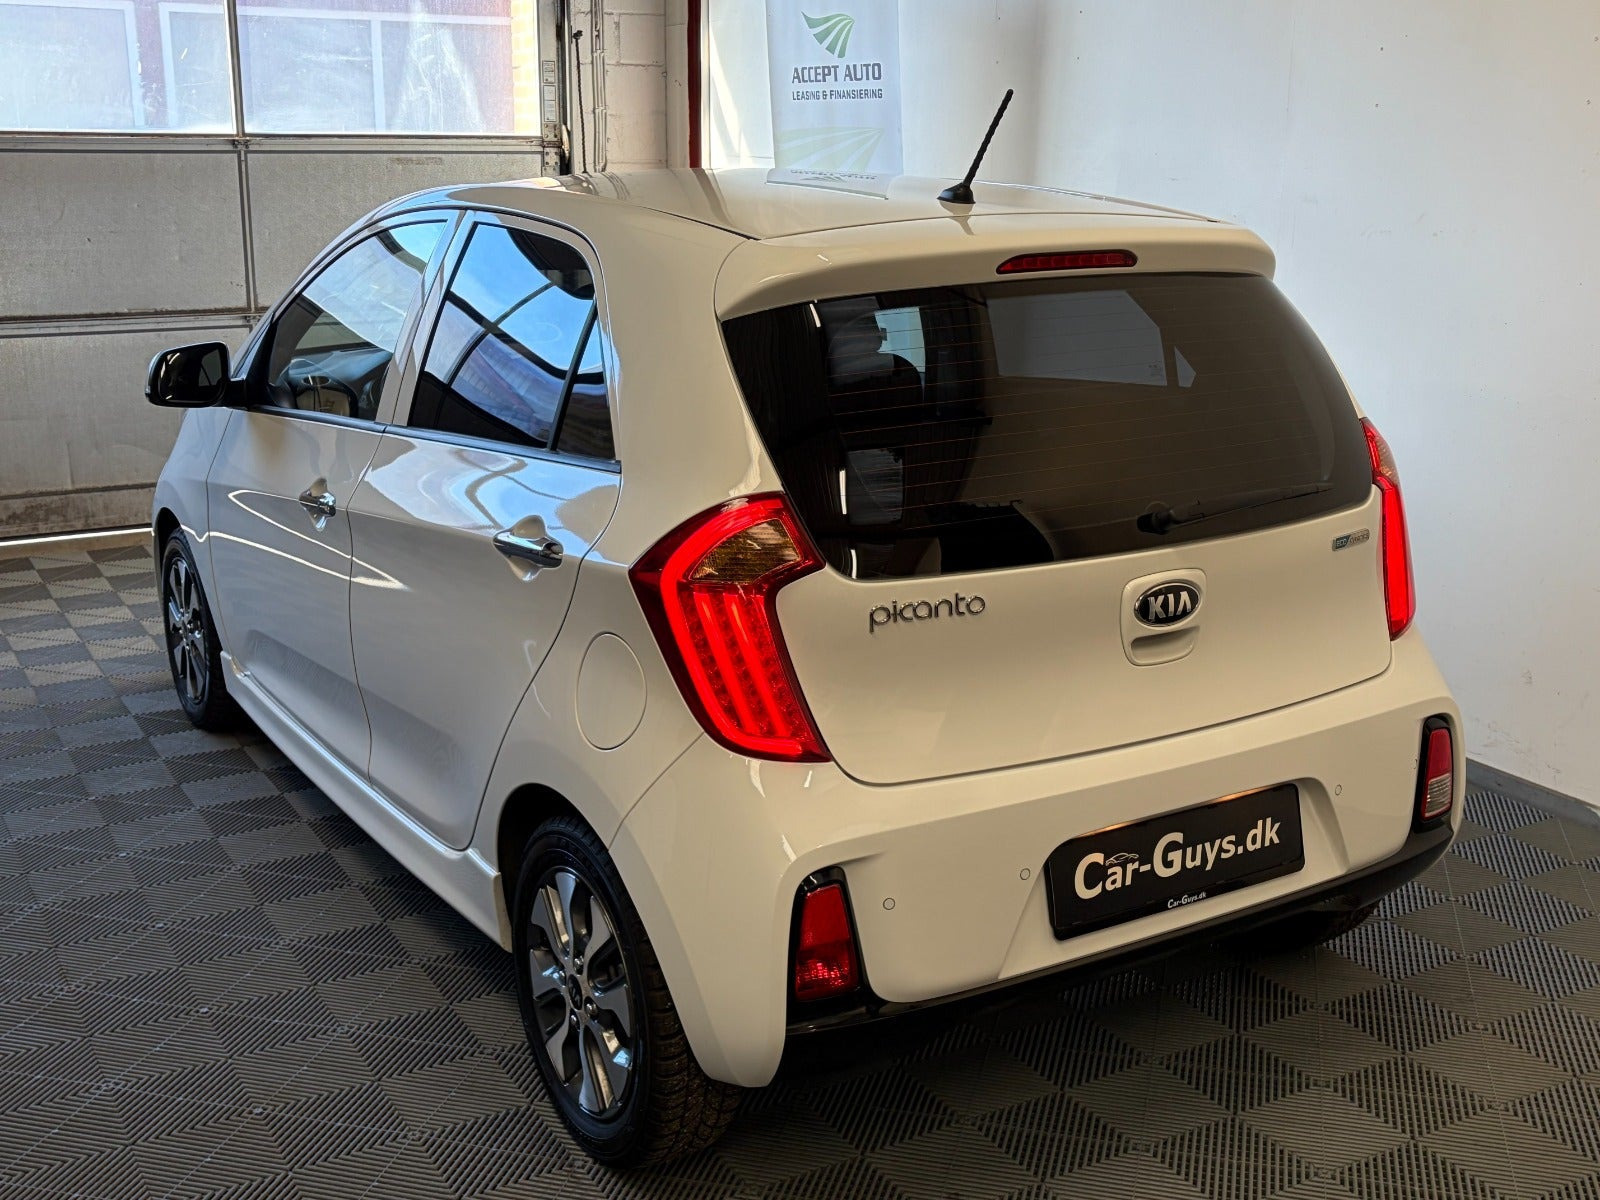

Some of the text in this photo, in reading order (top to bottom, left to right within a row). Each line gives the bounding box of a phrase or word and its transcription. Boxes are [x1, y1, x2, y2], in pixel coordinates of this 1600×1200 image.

[792, 62, 882, 83] ACCEPT AUTO
[792, 88, 883, 101] LEASING & FINANSIERING
[869, 592, 986, 633] picanto
[1148, 591, 1192, 620] KIA
[1074, 816, 1281, 900] Car-Guys.dk
[1167, 891, 1207, 909] Car-Guys.dk
